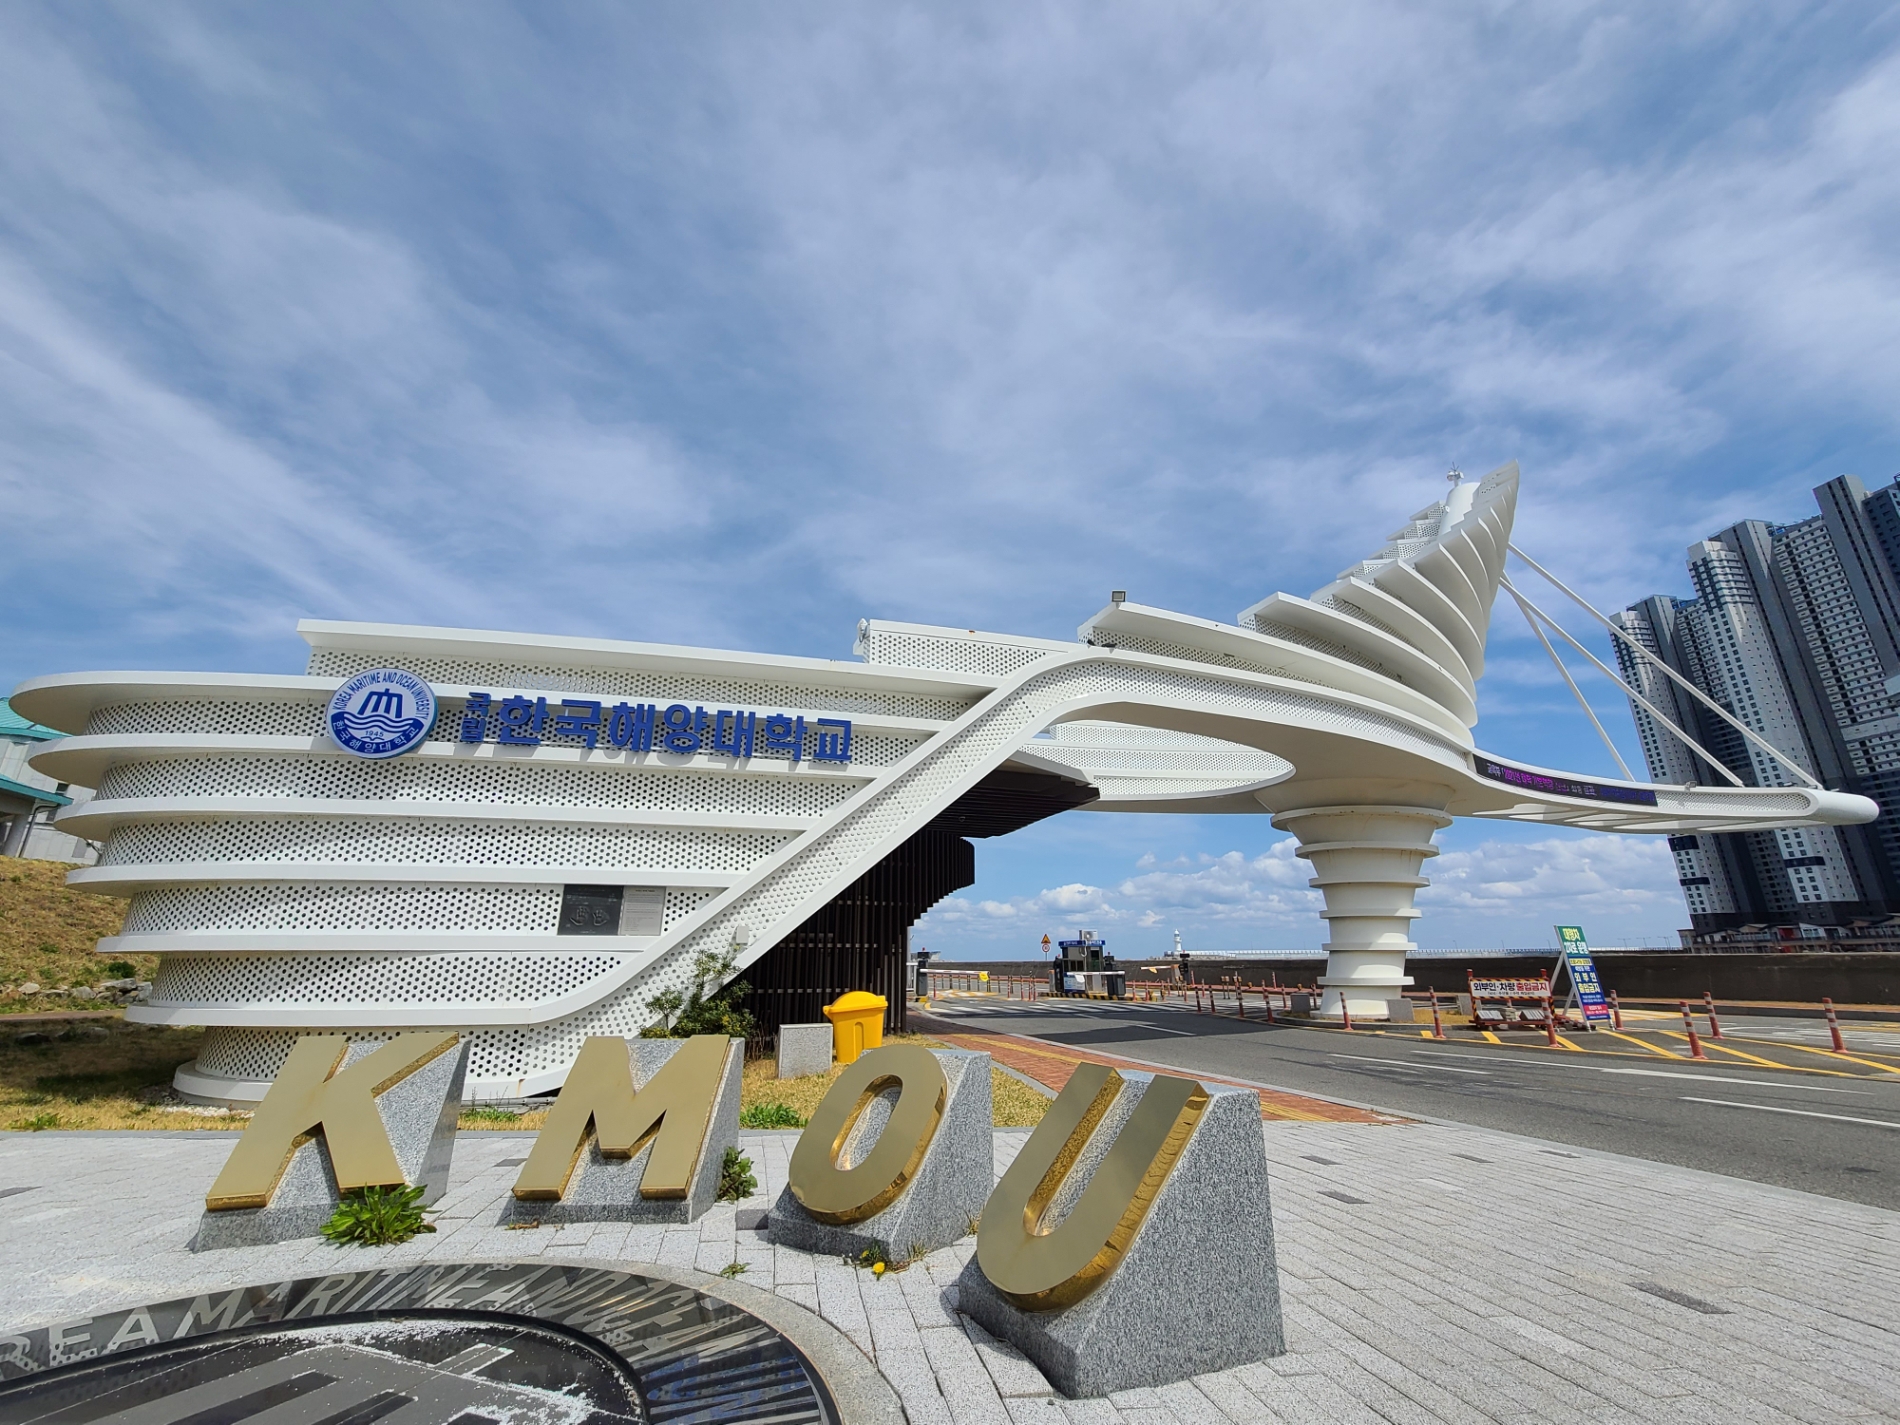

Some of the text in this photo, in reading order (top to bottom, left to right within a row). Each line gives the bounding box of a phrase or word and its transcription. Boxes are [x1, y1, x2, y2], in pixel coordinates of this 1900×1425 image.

[332, 671, 430, 720] KOREA MARITIME AND OCEAN UNIVERSITY
[460, 692, 491, 742] 국립
[333, 720, 419, 753] 한국해양대학교
[499, 694, 852, 763] 한국해양대학교
[1516, 982, 1548, 991] 출입금지
[206, 1031, 1208, 1312] KMOU
[171, 1264, 517, 1339] MARITIME
[463, 1265, 631, 1321] AND
